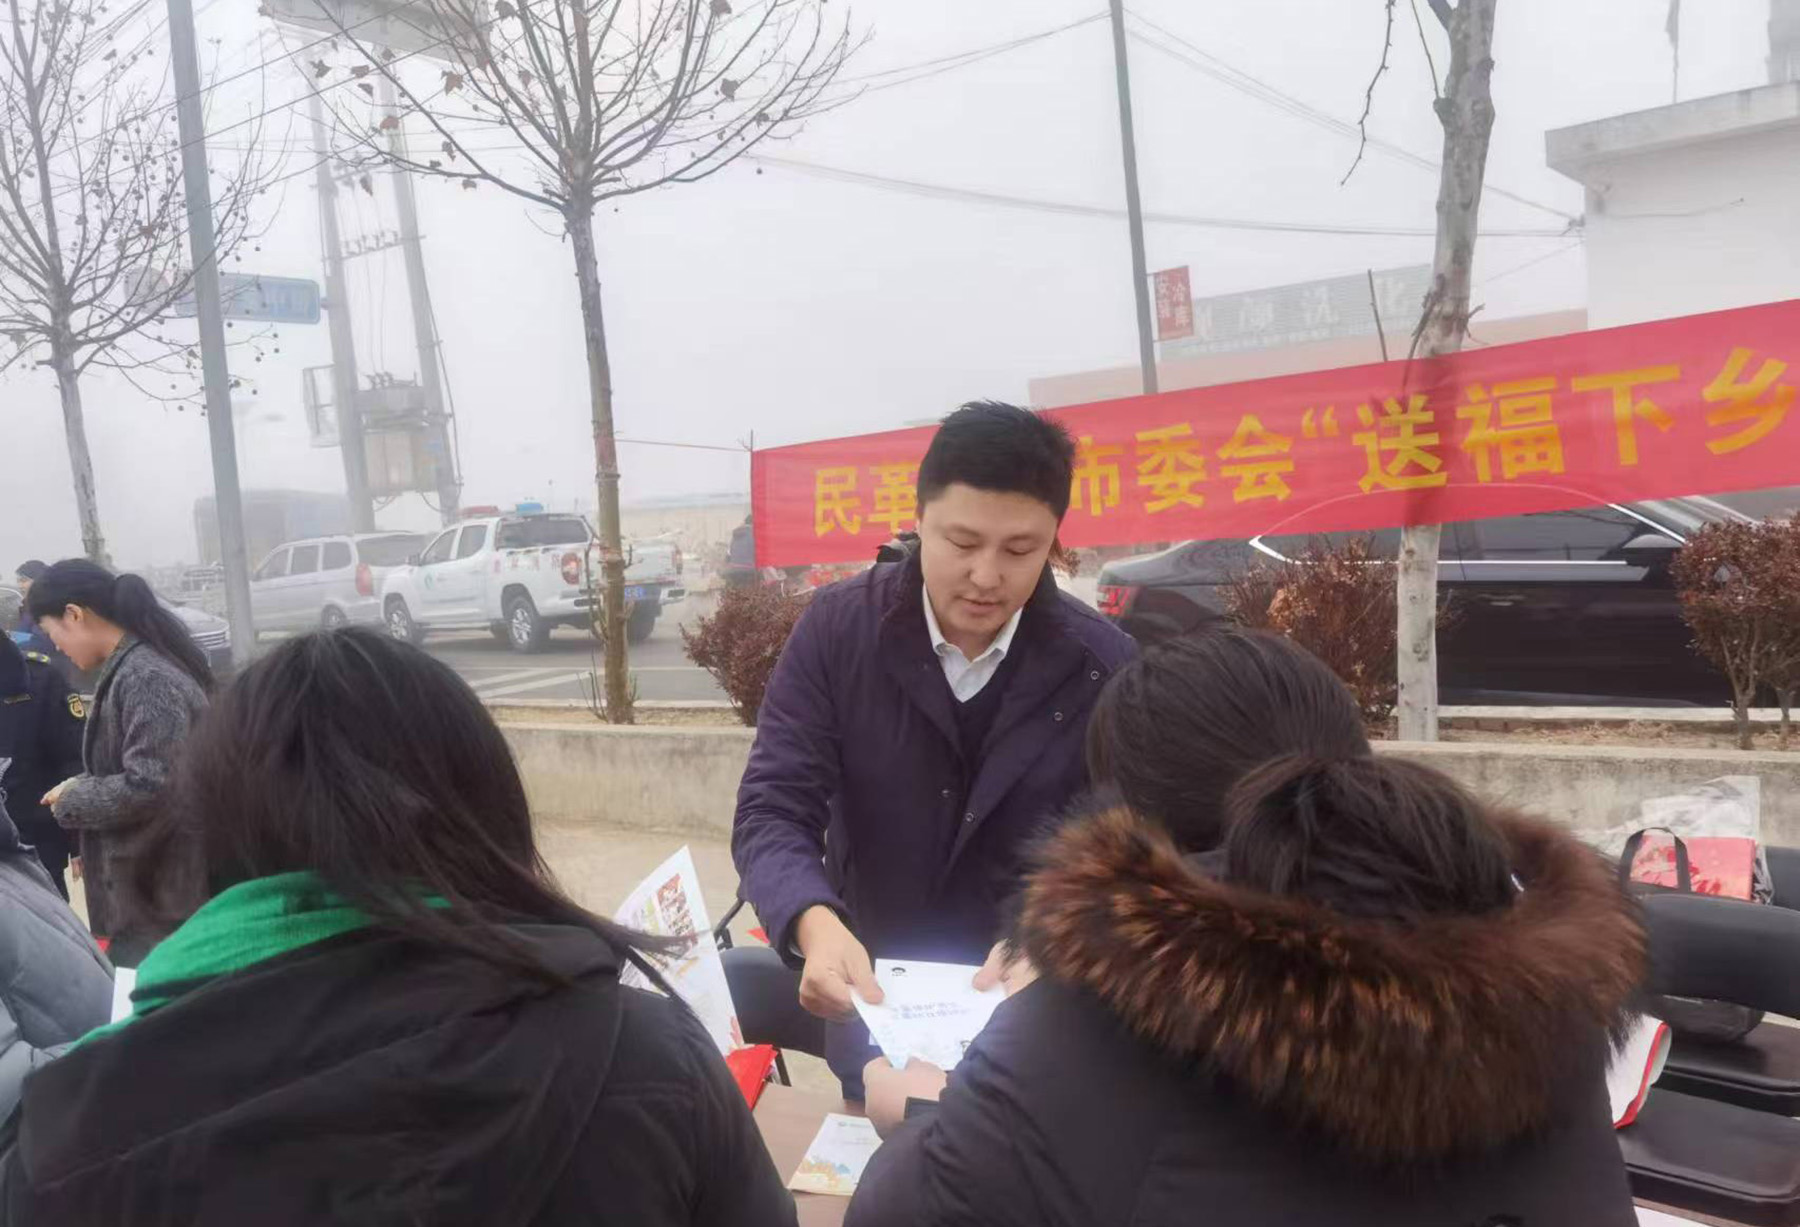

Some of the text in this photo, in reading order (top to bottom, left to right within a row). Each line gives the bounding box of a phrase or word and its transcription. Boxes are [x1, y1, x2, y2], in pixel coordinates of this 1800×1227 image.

[813, 347, 1796, 537] 民革市委会“送福下乡
